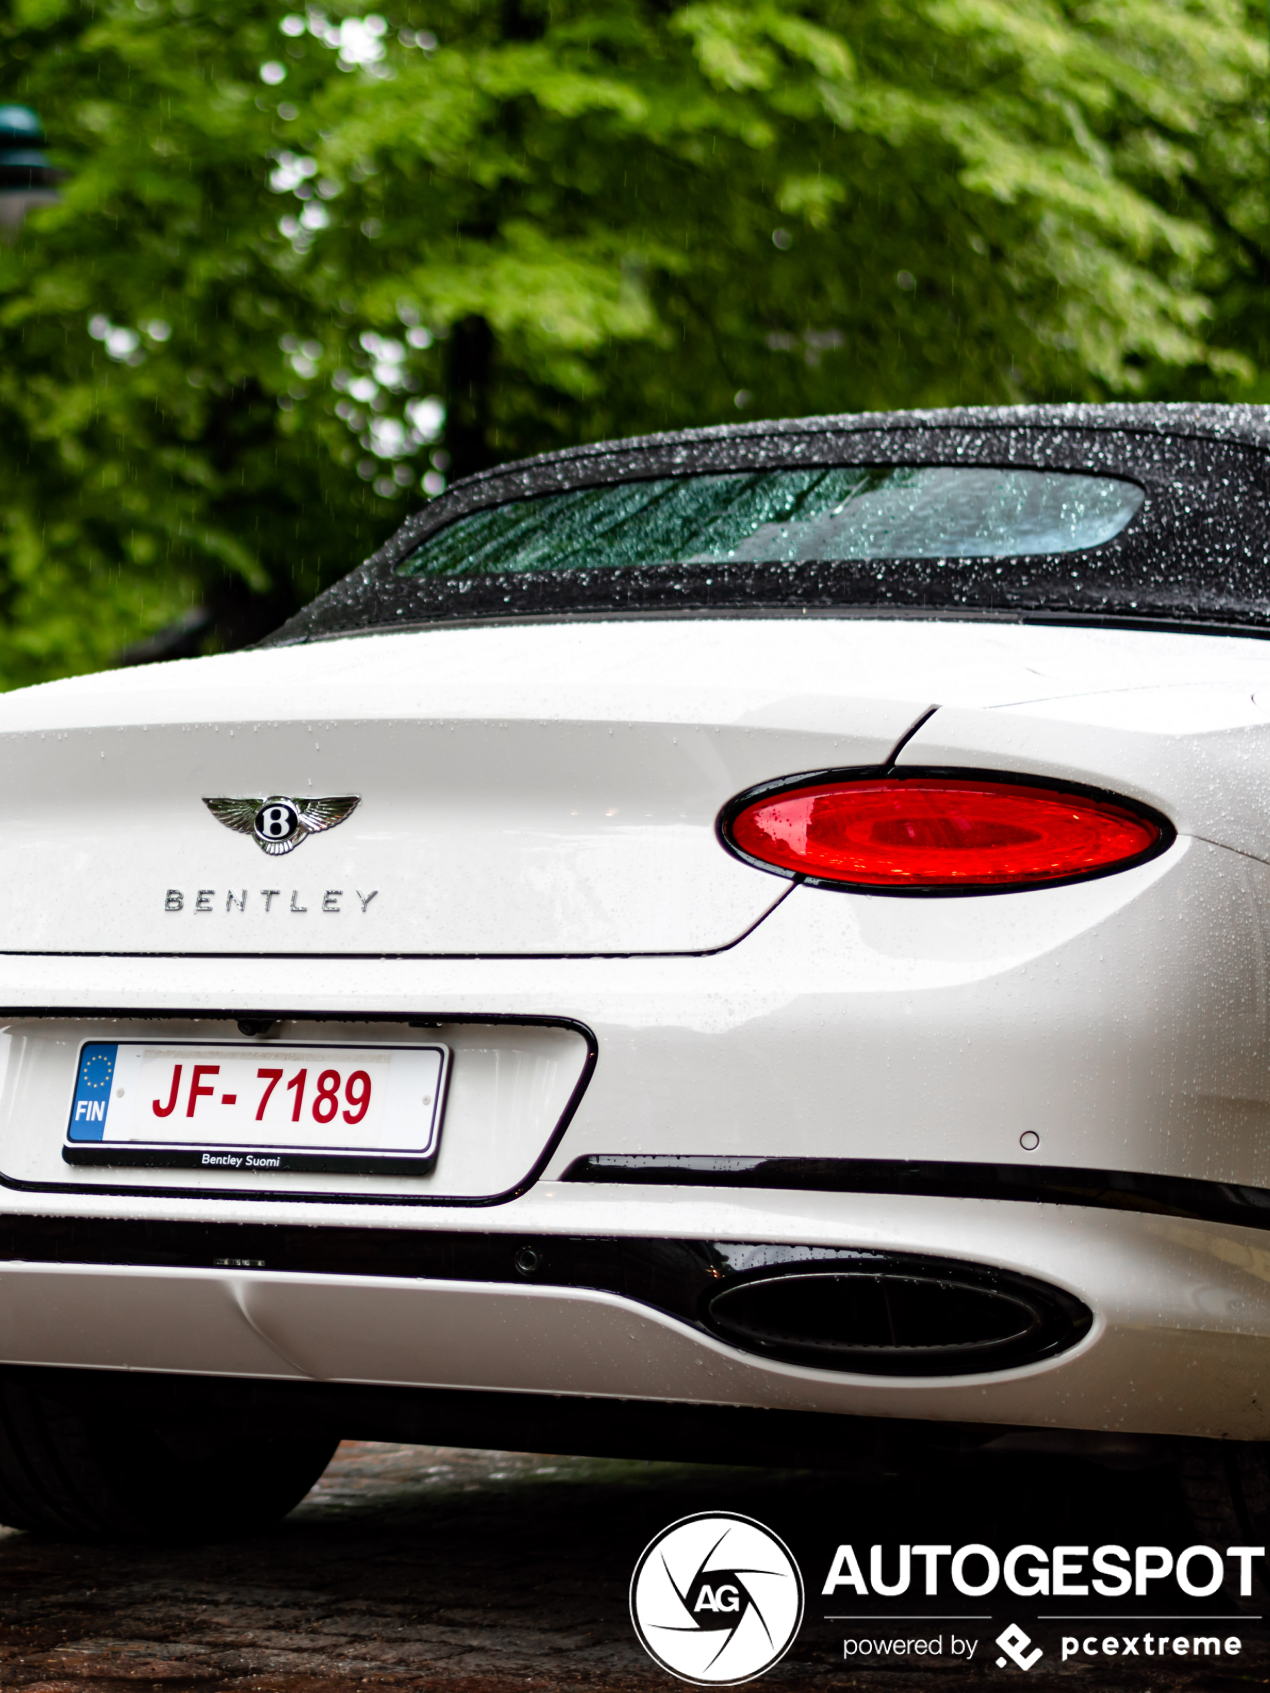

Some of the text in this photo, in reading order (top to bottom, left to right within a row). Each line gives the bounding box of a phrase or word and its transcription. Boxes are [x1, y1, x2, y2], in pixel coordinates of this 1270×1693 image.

[164, 889, 378, 912] BENTLEY
[75, 1100, 106, 1121] FIN
[201, 1153, 280, 1168] Bentley Suomi
